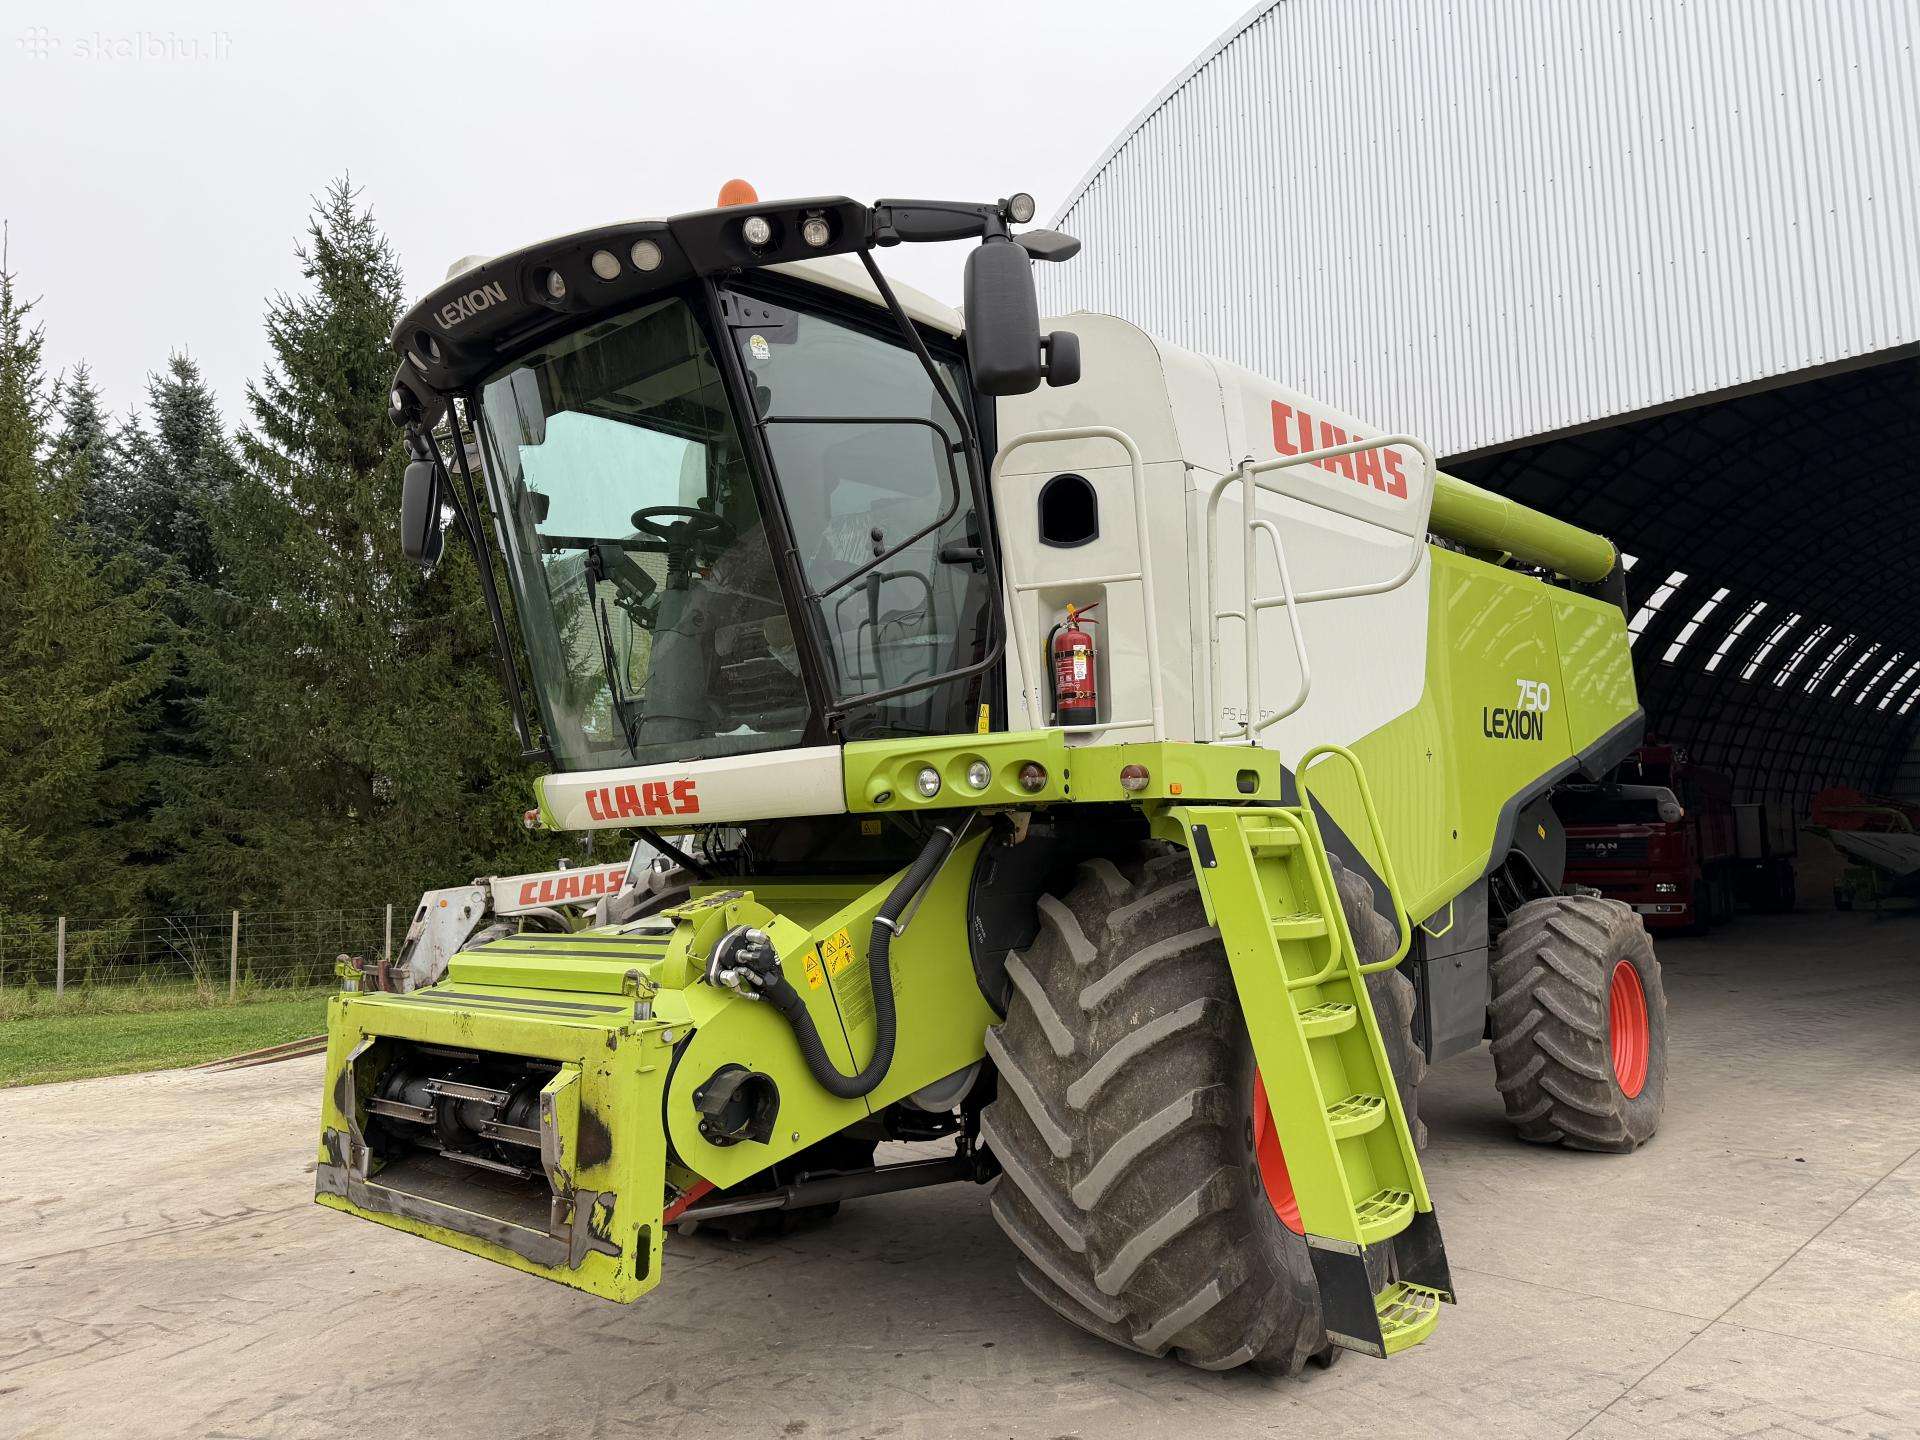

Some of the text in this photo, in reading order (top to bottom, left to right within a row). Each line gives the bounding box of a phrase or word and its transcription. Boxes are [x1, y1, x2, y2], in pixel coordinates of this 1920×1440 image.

[433, 281, 508, 330] LEXION
[1271, 399, 1408, 500] CLAAS
[1516, 679, 1551, 712] 750
[1483, 706, 1544, 741] LEXION
[585, 780, 700, 821] CLAAS
[1584, 842, 1618, 850] MAN
[519, 869, 628, 906] CLAAS
